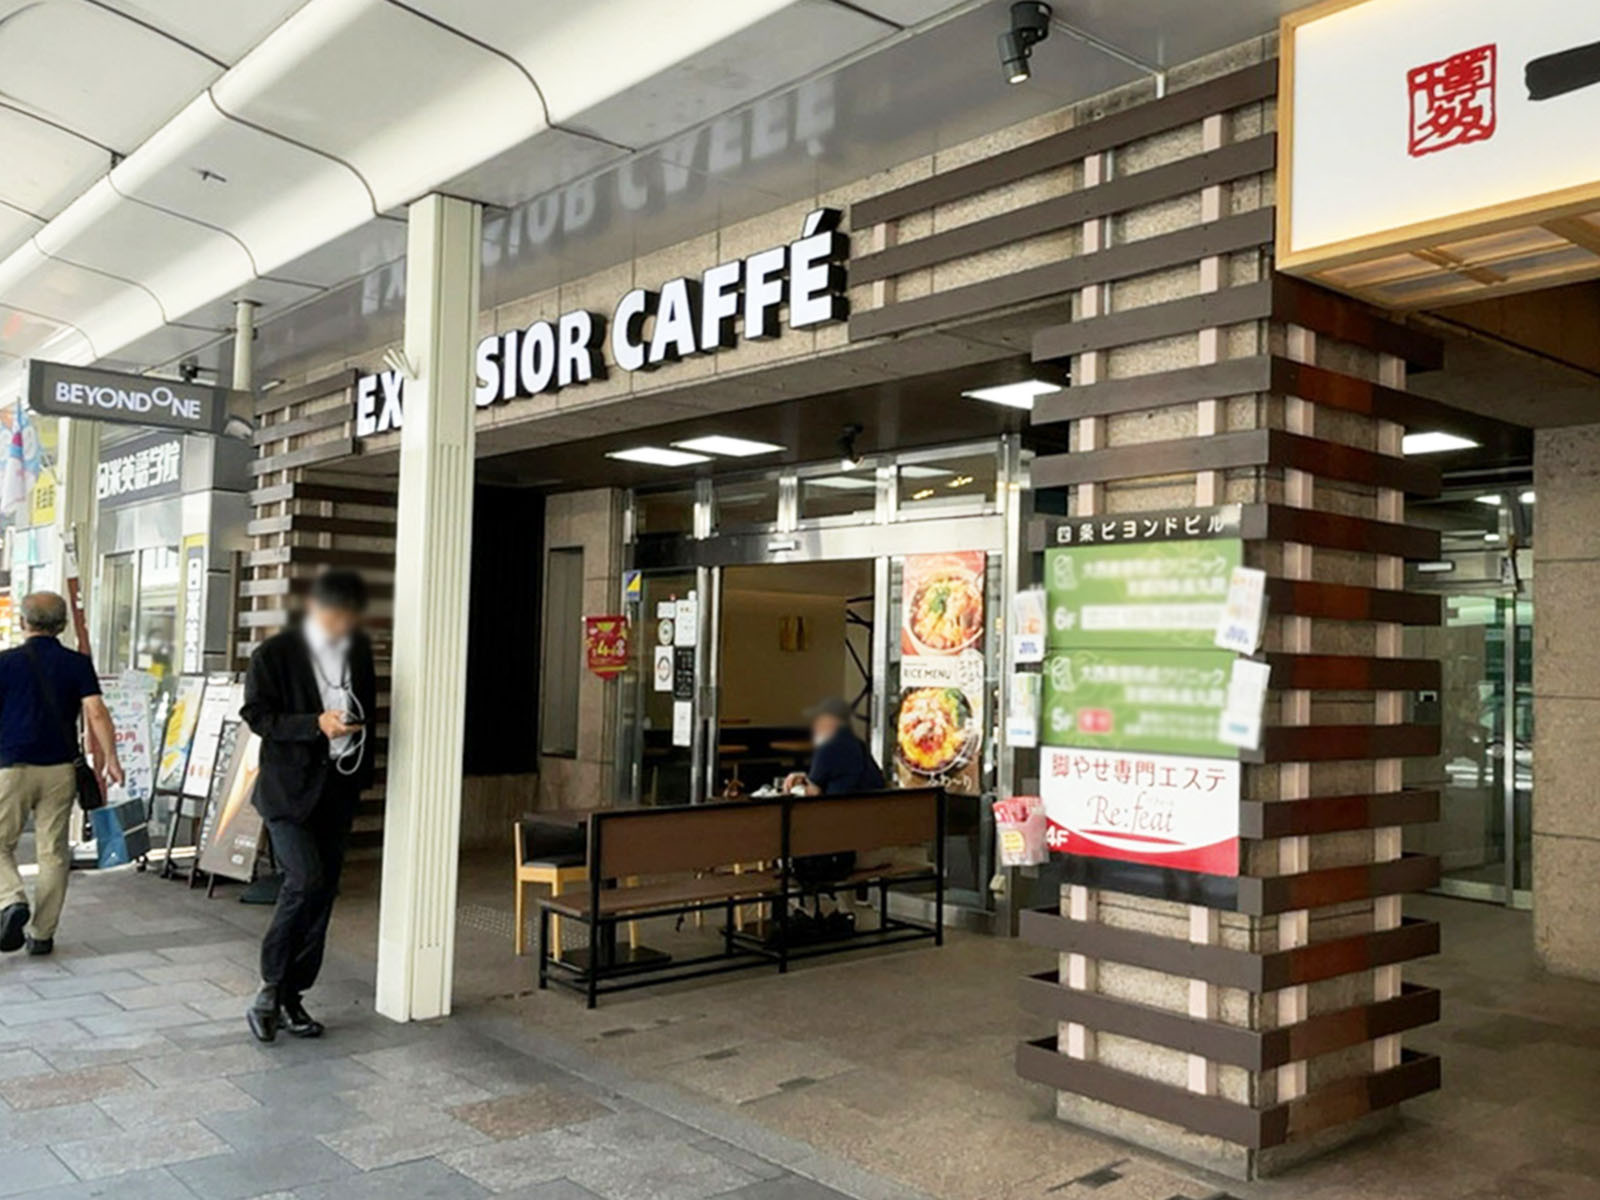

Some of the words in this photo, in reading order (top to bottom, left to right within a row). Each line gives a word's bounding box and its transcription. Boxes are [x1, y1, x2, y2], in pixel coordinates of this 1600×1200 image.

[356, 309, 594, 437] EXSIOR
[612, 208, 840, 372] CAFFÉ
[1056, 514, 1225, 544] 四条ビヨンドビル
[1052, 753, 1227, 792] 脚やせ専門エステ
[1045, 825, 1070, 847] 4F
